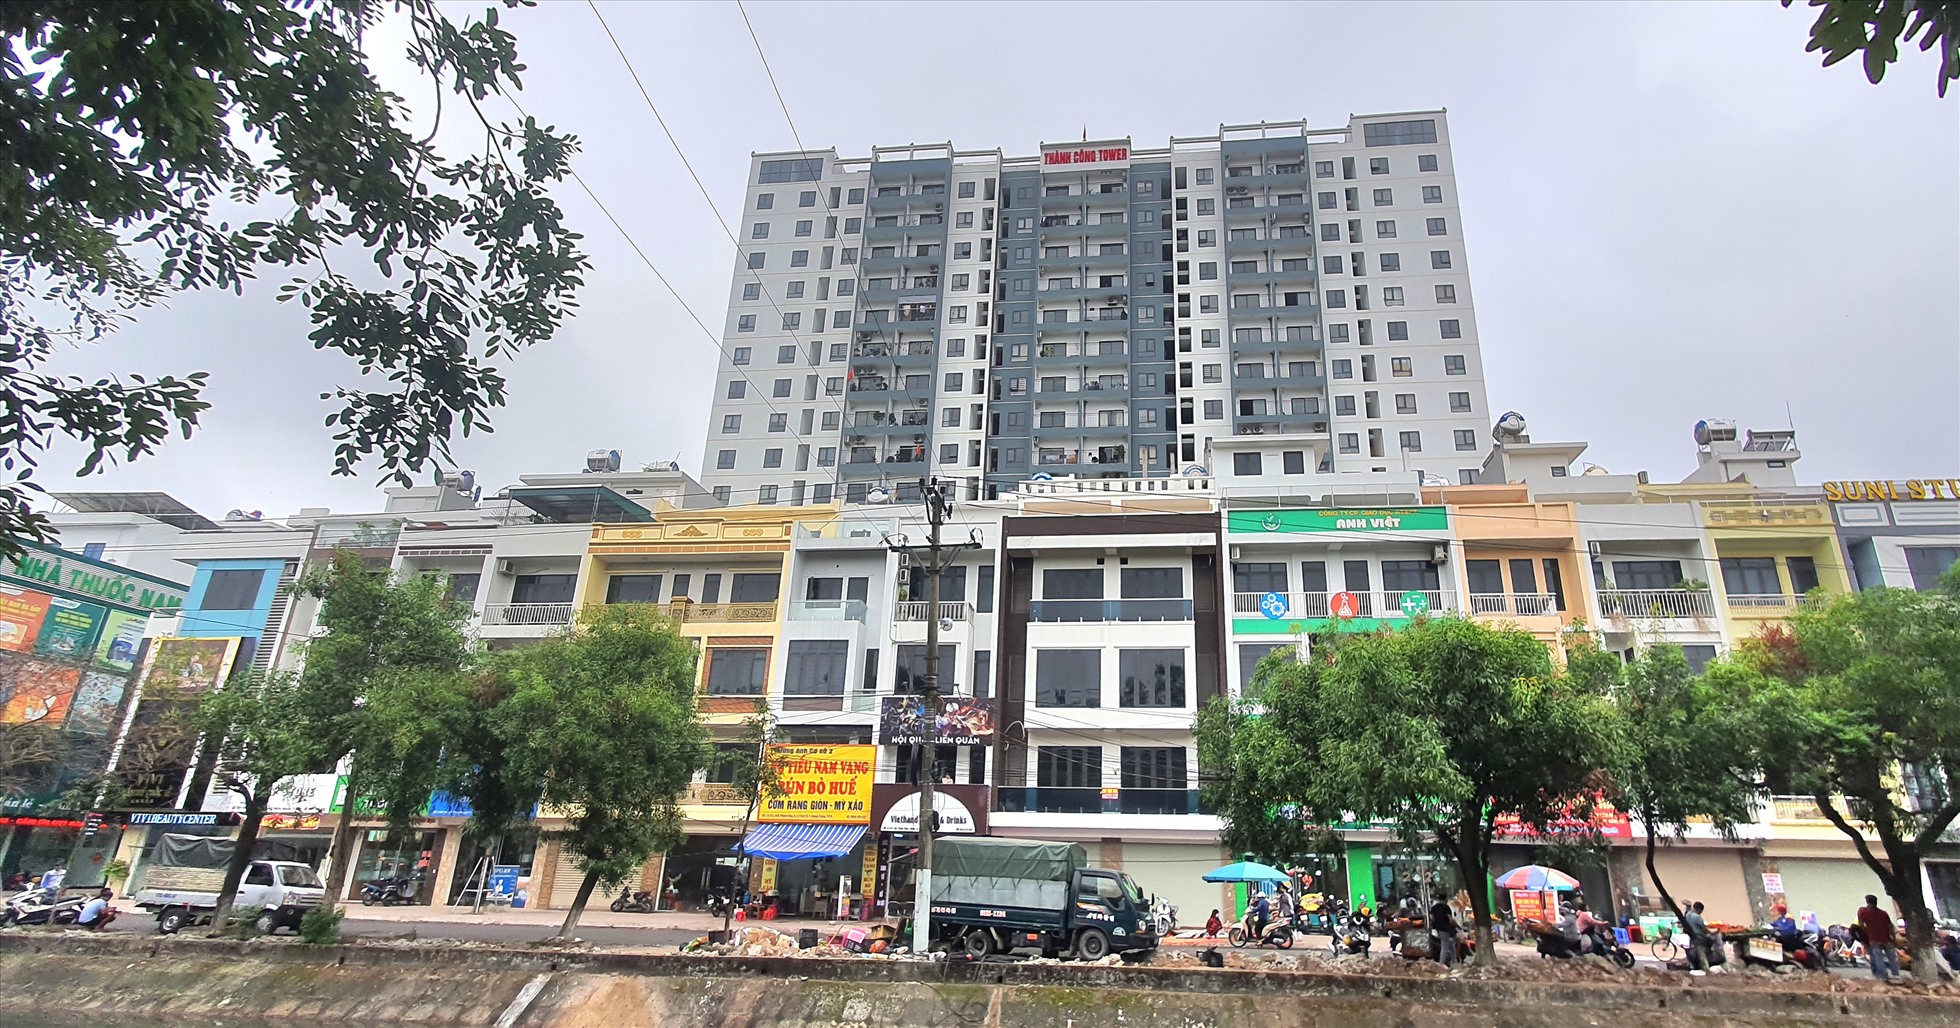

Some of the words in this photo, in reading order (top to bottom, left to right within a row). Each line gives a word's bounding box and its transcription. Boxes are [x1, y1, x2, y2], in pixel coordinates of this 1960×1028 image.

[1044, 150, 1071, 165] THÀNH
[1073, 148, 1096, 163] CÔNG
[1098, 148, 1127, 161] TOWER
[1823, 481, 1899, 501] SUNI
[1336, 518, 1367, 529] ANH
[1369, 515, 1401, 531] VIỆT
[14, 555, 63, 586] NHÀ
[70, 569, 136, 603] THUỐC
[138, 588, 183, 609] NAM
[814, 760, 837, 775] NAM
[840, 761, 869, 775] VANG
[807, 776, 826, 795] BÒ
[829, 775, 857, 795] HUẾ
[787, 799, 808, 810] RANG
[946, 816, 967, 825] Drinks
